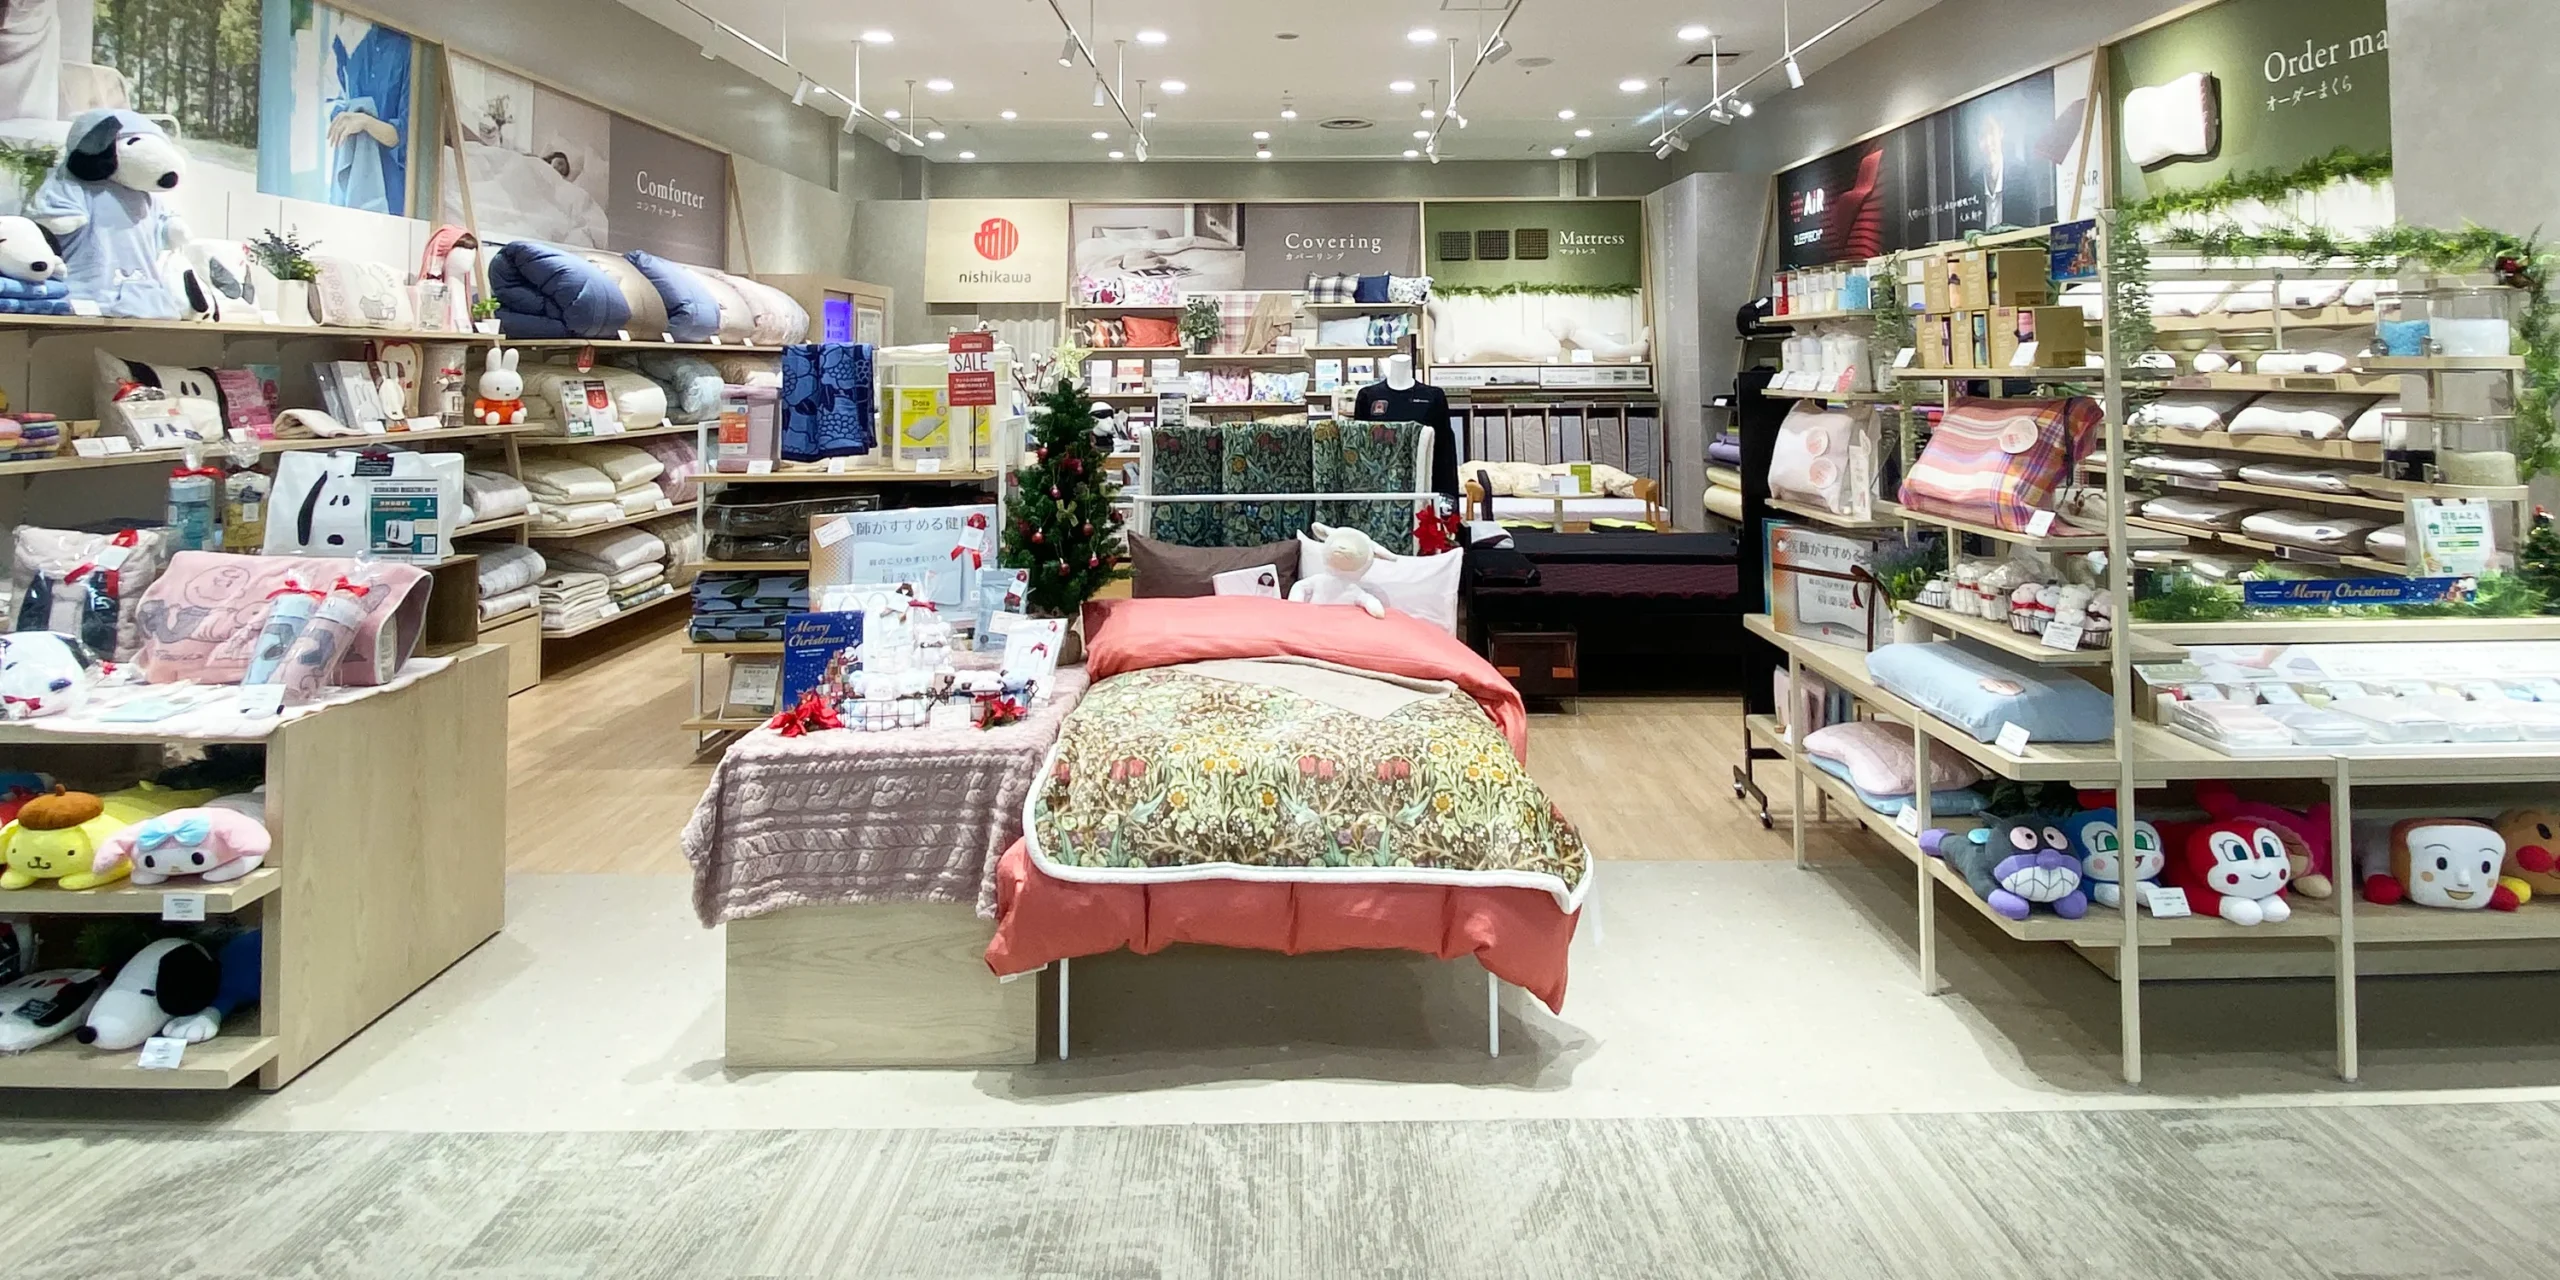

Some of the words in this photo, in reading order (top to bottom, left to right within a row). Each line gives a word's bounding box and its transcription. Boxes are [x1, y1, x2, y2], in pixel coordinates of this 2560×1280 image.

[2264, 38, 2340, 83] Order
[2266, 74, 2353, 112] オーダーまくら
[636, 170, 705, 209] Comforter
[1285, 232, 1382, 254] Covering
[1559, 230, 1625, 245] Mattress
[1286, 252, 1345, 261] カバーリング
[1559, 247, 1597, 256] マットレス
[959, 270, 1032, 284] nishikawa
[954, 352, 988, 372] SALE
[2284, 583, 2332, 600] Merry
[2335, 582, 2401, 597] Christmas
[789, 620, 831, 637] Merry
[788, 633, 846, 647] Christmas
